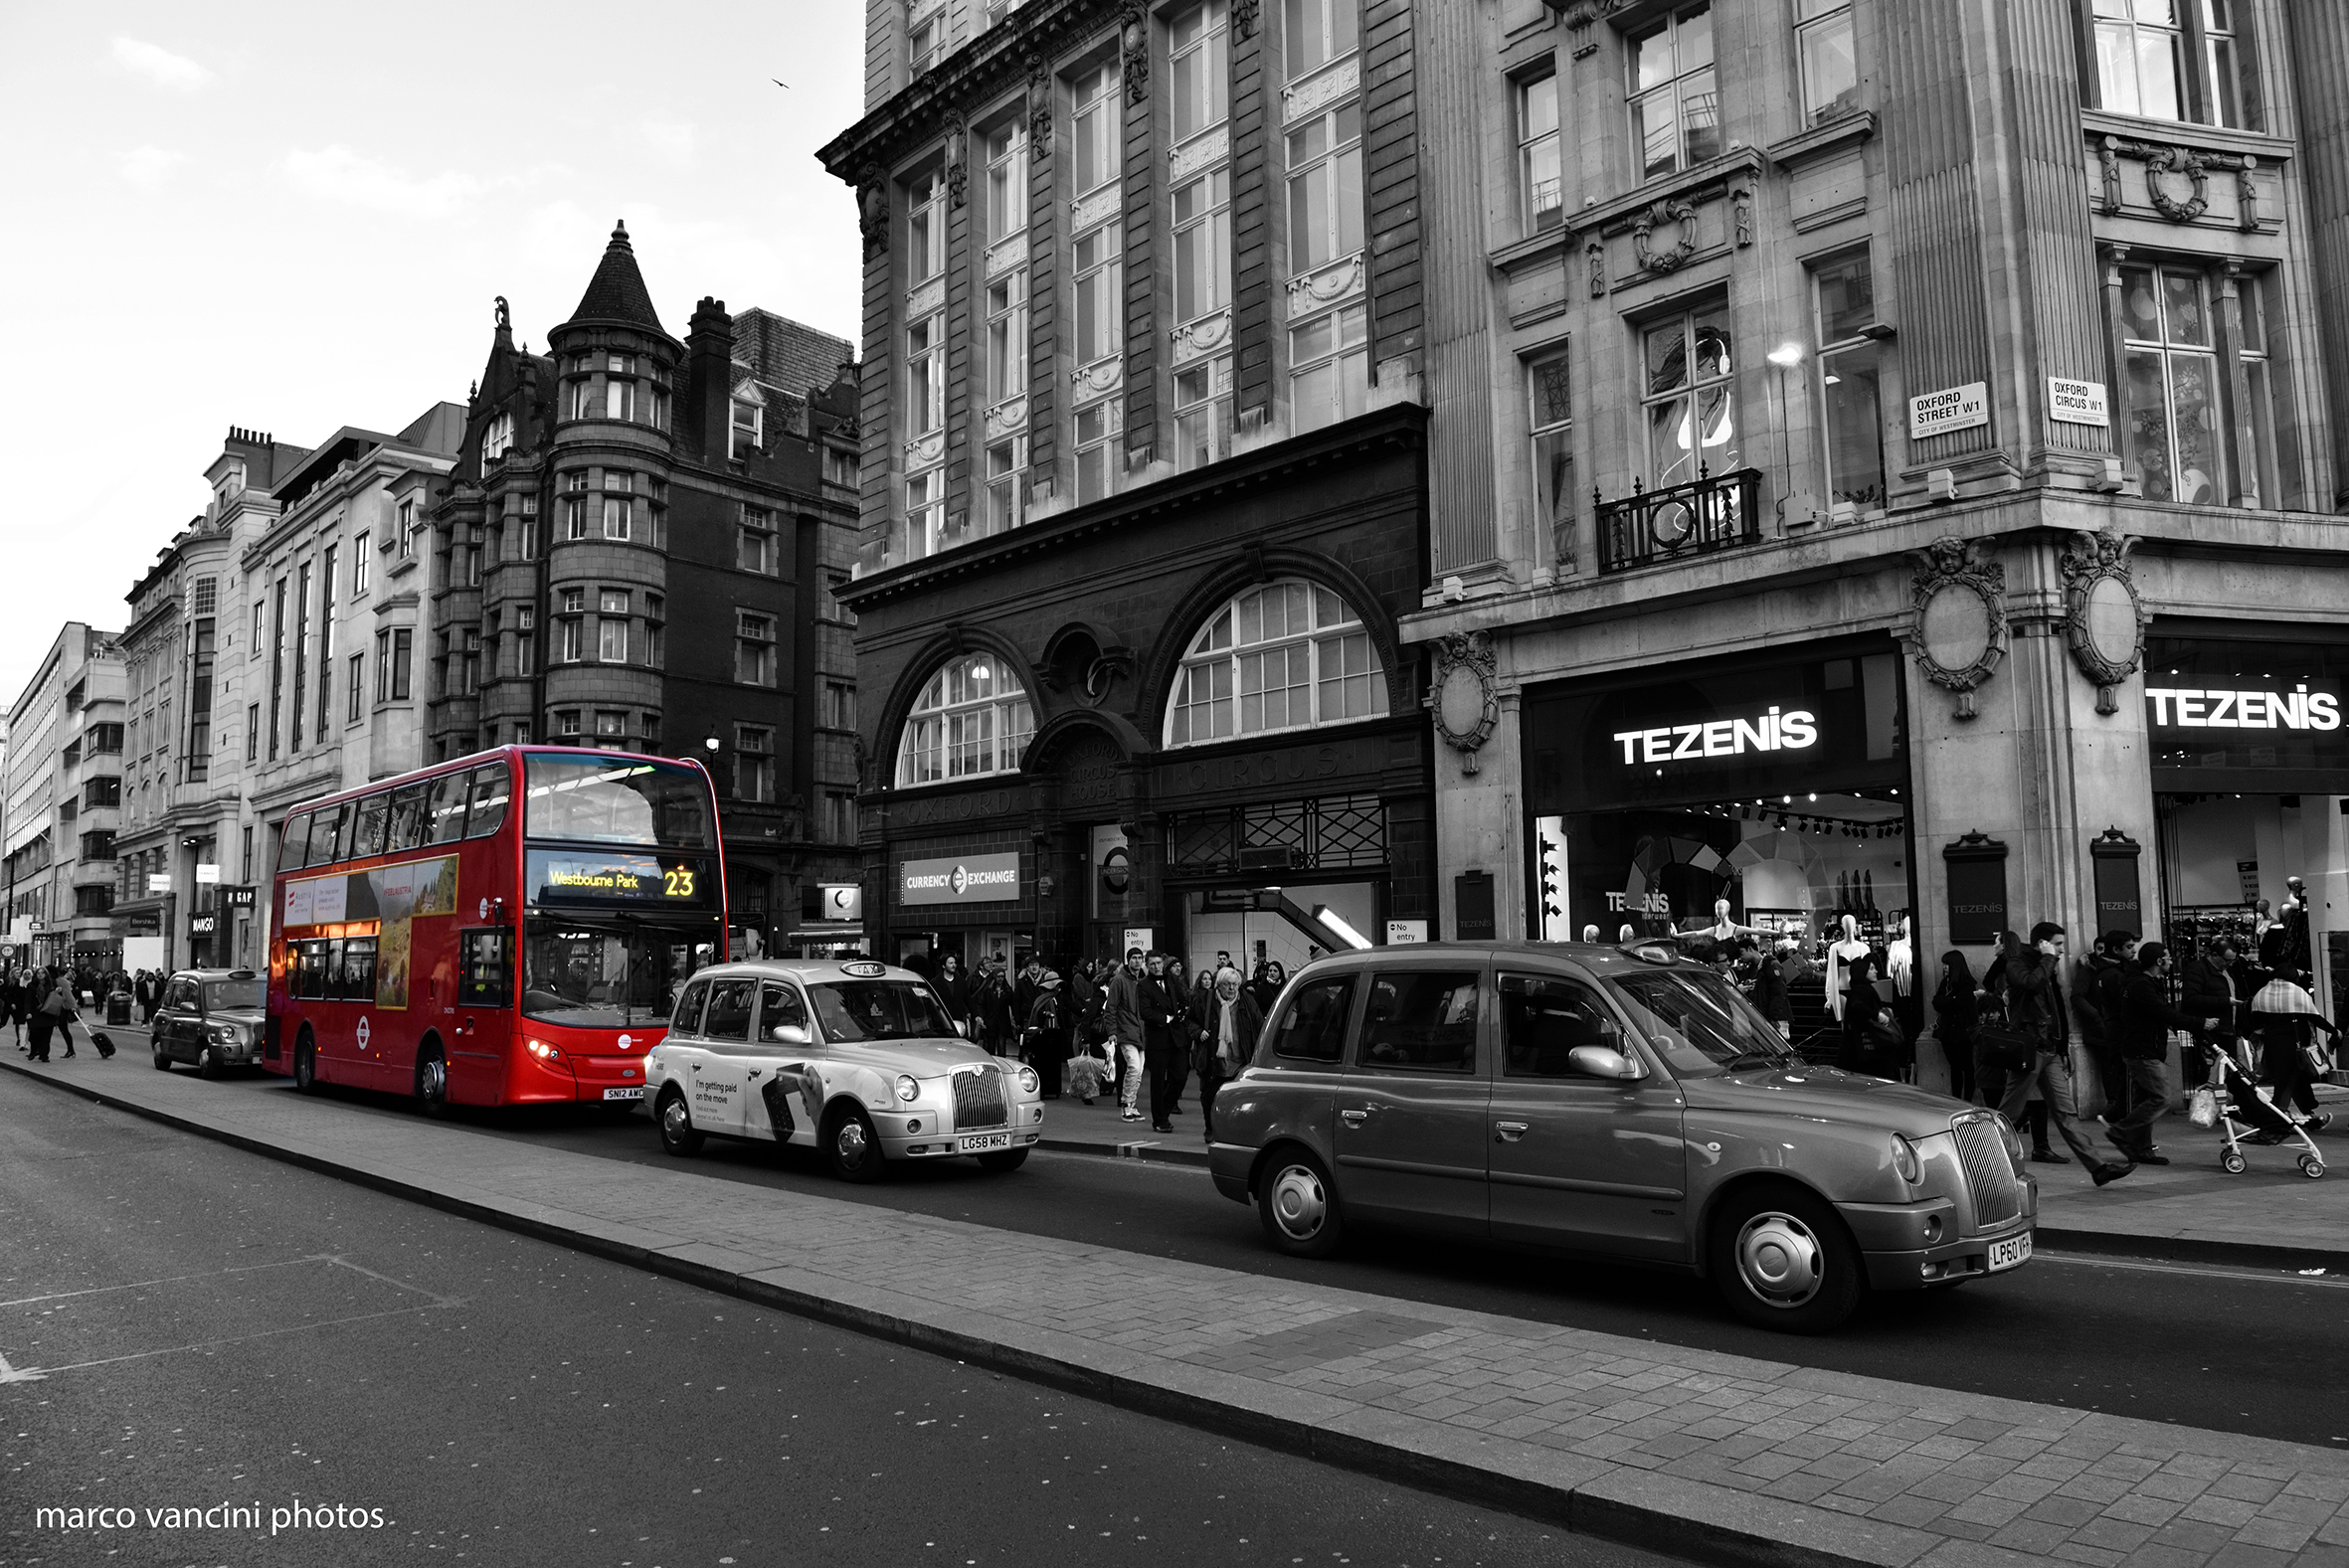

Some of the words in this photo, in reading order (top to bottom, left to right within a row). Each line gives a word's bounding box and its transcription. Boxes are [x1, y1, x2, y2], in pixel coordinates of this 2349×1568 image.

[2055, 382, 2088, 397] OXFORD
[1916, 392, 1961, 411] OXFORD
[2055, 395, 2087, 410] CIRCUS
[2089, 400, 2103, 412] W1
[1917, 405, 1959, 424] STREET
[1962, 401, 1980, 414] W1
[2073, 414, 2100, 423] WESTMINSTER
[1918, 427, 1930, 436] CITY
[1939, 418, 1976, 432] WESTMINSTER
[1067, 743, 1119, 768] OXFORD
[1071, 765, 1116, 784] CIRCUS
[1188, 748, 1339, 790] CIRCUS
[1071, 784, 1116, 801] HOUSE
[907, 791, 1012, 824] OXFORD
[550, 870, 613, 887] Westbourne
[617, 874, 638, 889] Park
[664, 871, 694, 897] 23
[907, 874, 950, 889] CURRENCY
[968, 870, 1015, 886] EXCHANGE
[237, 892, 253, 903] GAP
[1605, 889, 1670, 913] TENIS
[193, 917, 214, 933] MANGO
[1396, 933, 1416, 942] entry
[705, 1082, 724, 1094] getting
[725, 1084, 738, 1094] paid
[963, 1137, 989, 1149] LG58
[991, 1135, 1006, 1147] MHZ
[1993, 1241, 2018, 1265] LP60
